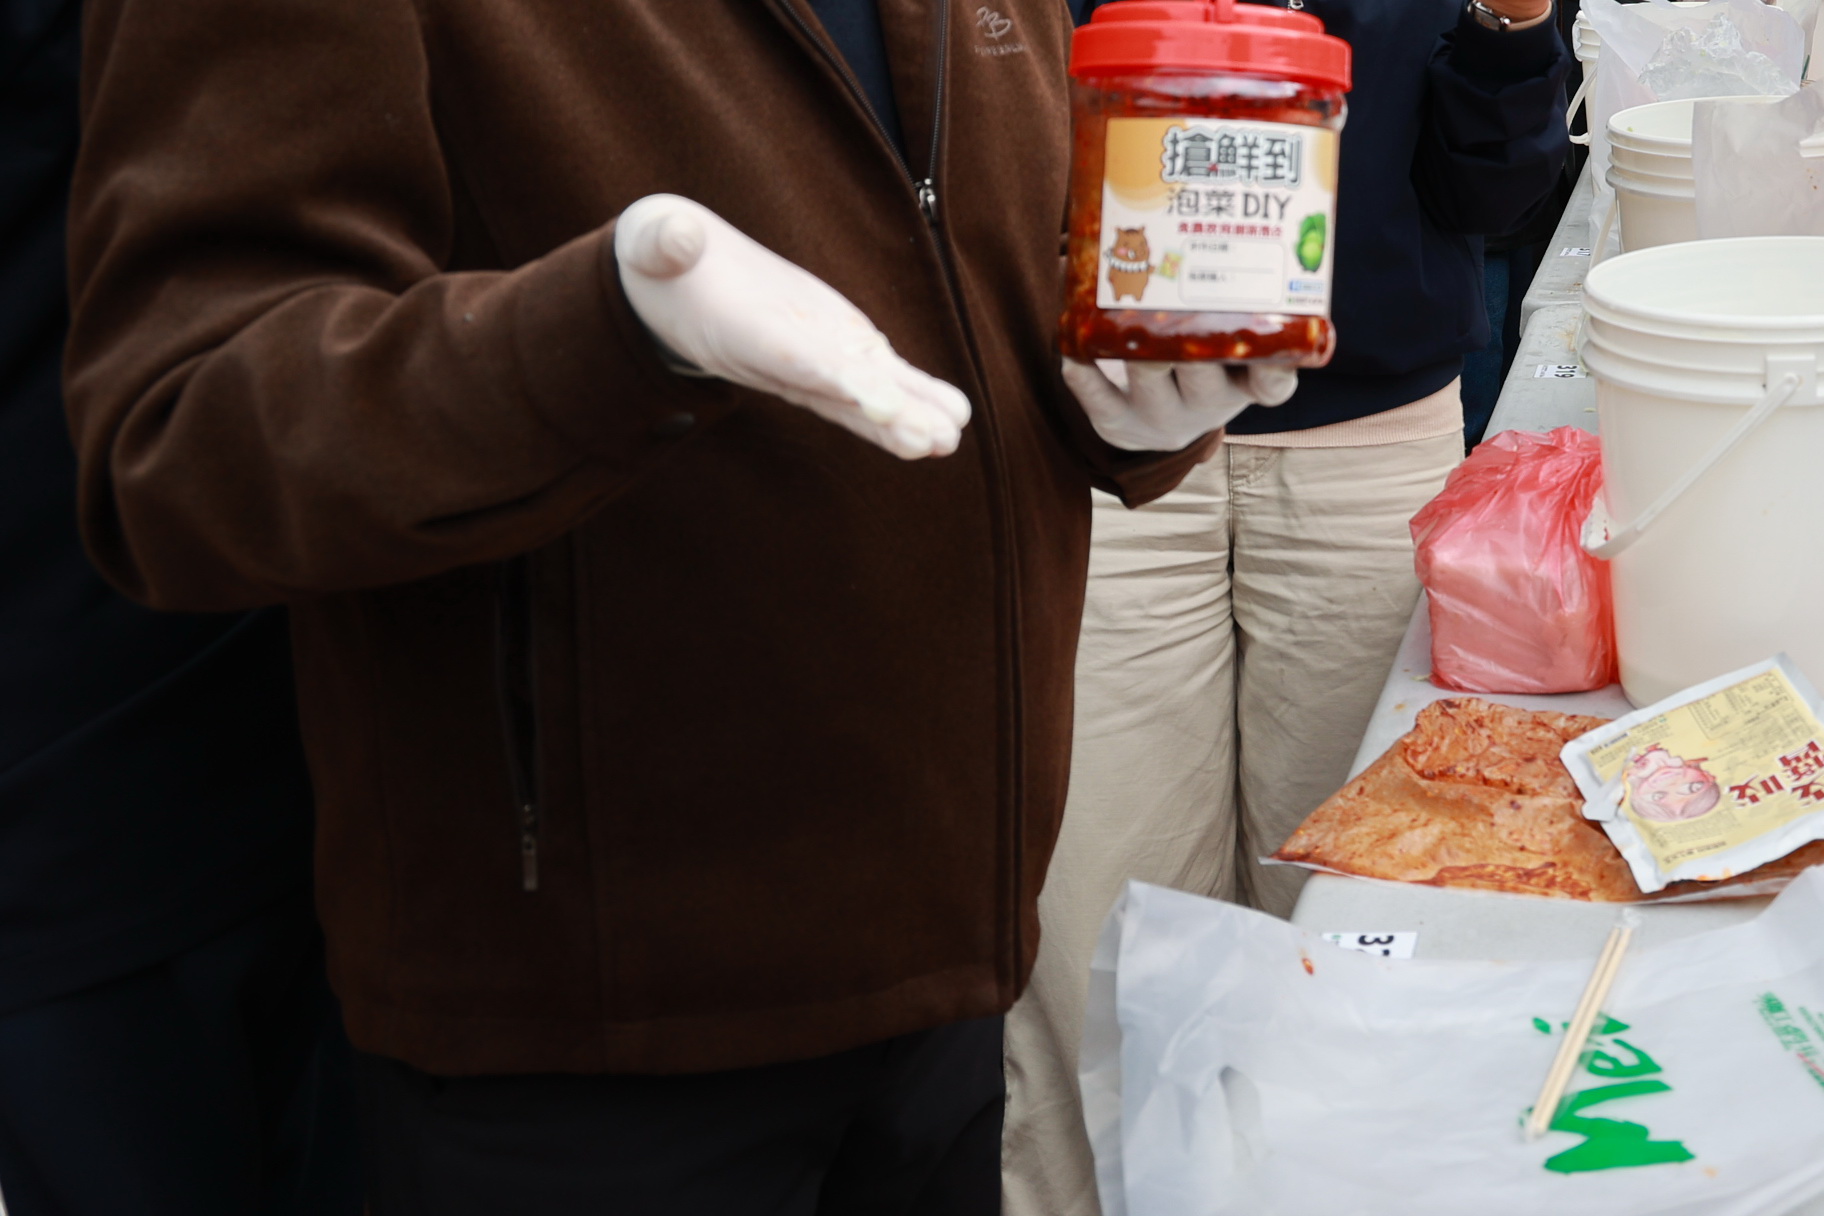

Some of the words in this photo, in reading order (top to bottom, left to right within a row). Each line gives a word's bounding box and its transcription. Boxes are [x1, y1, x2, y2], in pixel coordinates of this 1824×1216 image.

[1165, 128, 1300, 186] 搶鮮到
[1554, 365, 1577, 378] 319
